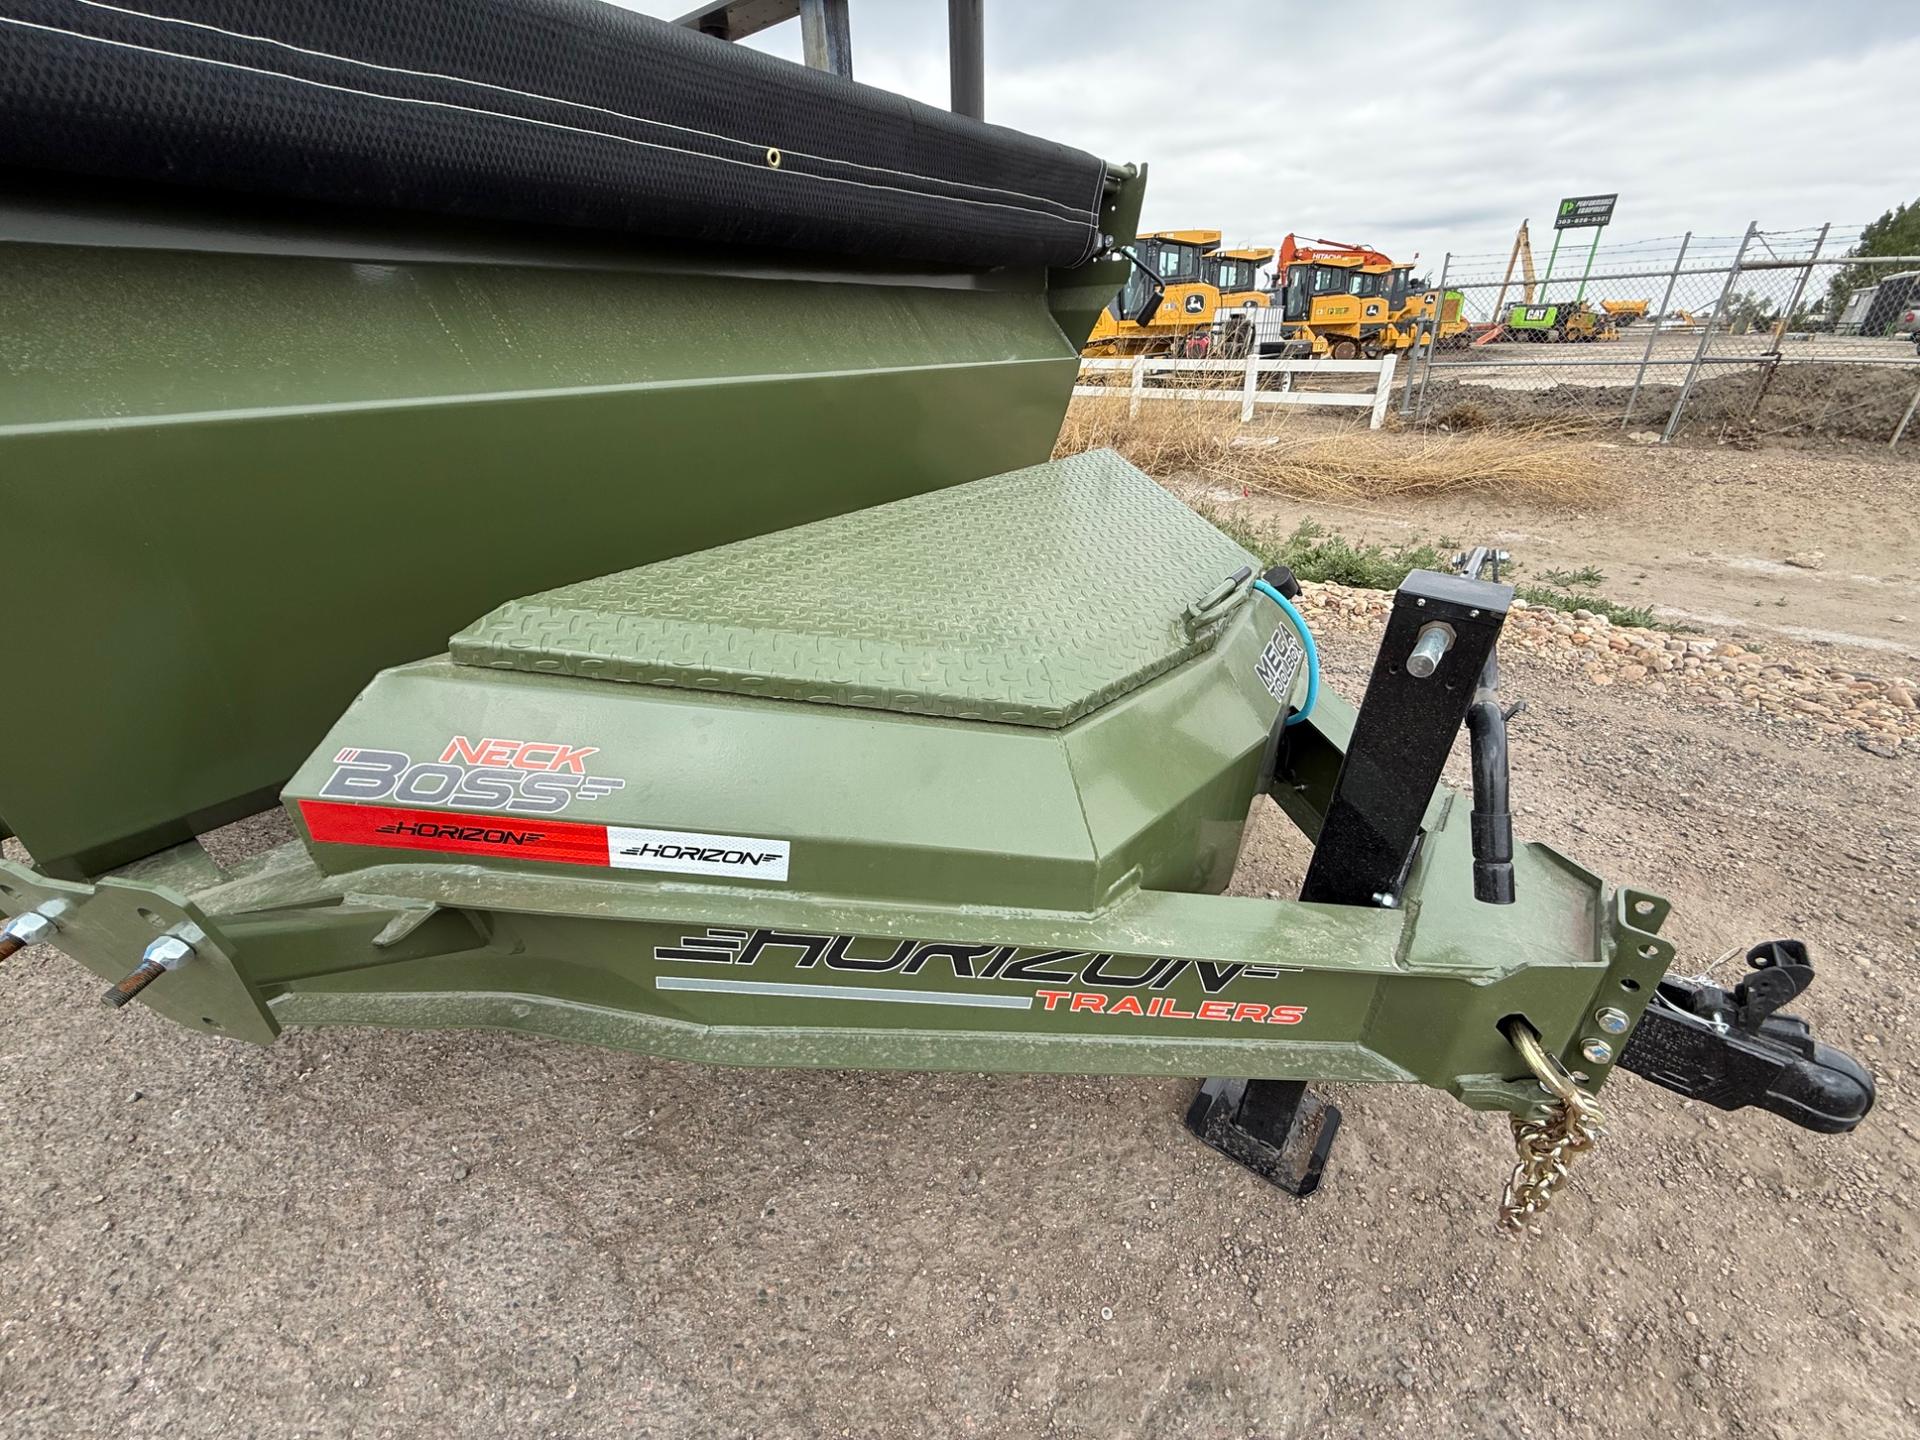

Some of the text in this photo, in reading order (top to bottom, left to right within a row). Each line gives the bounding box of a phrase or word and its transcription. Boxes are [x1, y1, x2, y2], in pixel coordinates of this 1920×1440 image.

[1526, 309, 1546, 321] CAT
[1254, 621, 1296, 690] MEGA
[1269, 641, 1304, 703] TOOLBOX
[438, 735, 601, 774] NECK
[318, 747, 585, 814] BOSS
[393, 821, 527, 845] HORIZON
[637, 843, 767, 866] HORIZON
[1035, 989, 1308, 1025] TRAILERS
